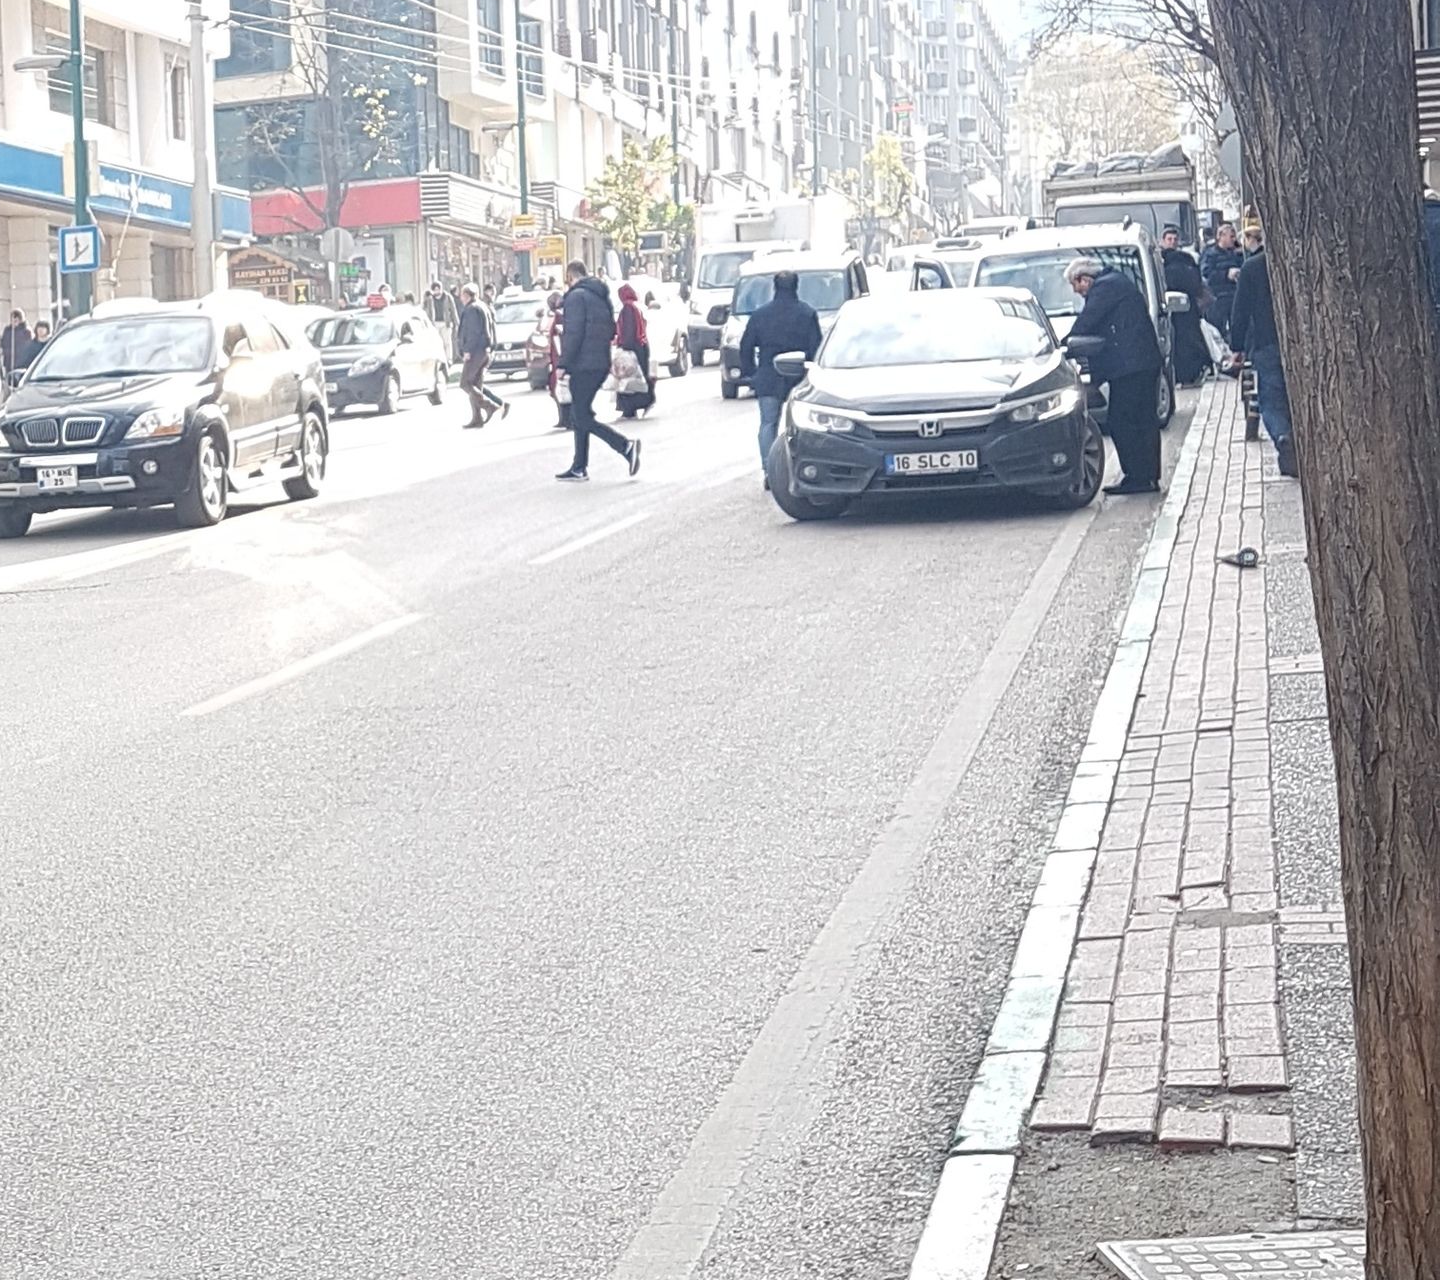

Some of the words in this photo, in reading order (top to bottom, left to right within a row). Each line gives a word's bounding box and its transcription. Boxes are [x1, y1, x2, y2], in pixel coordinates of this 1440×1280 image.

[895, 456, 911, 470] 16
[918, 453, 951, 469] SLC
[958, 451, 975, 466] 10
